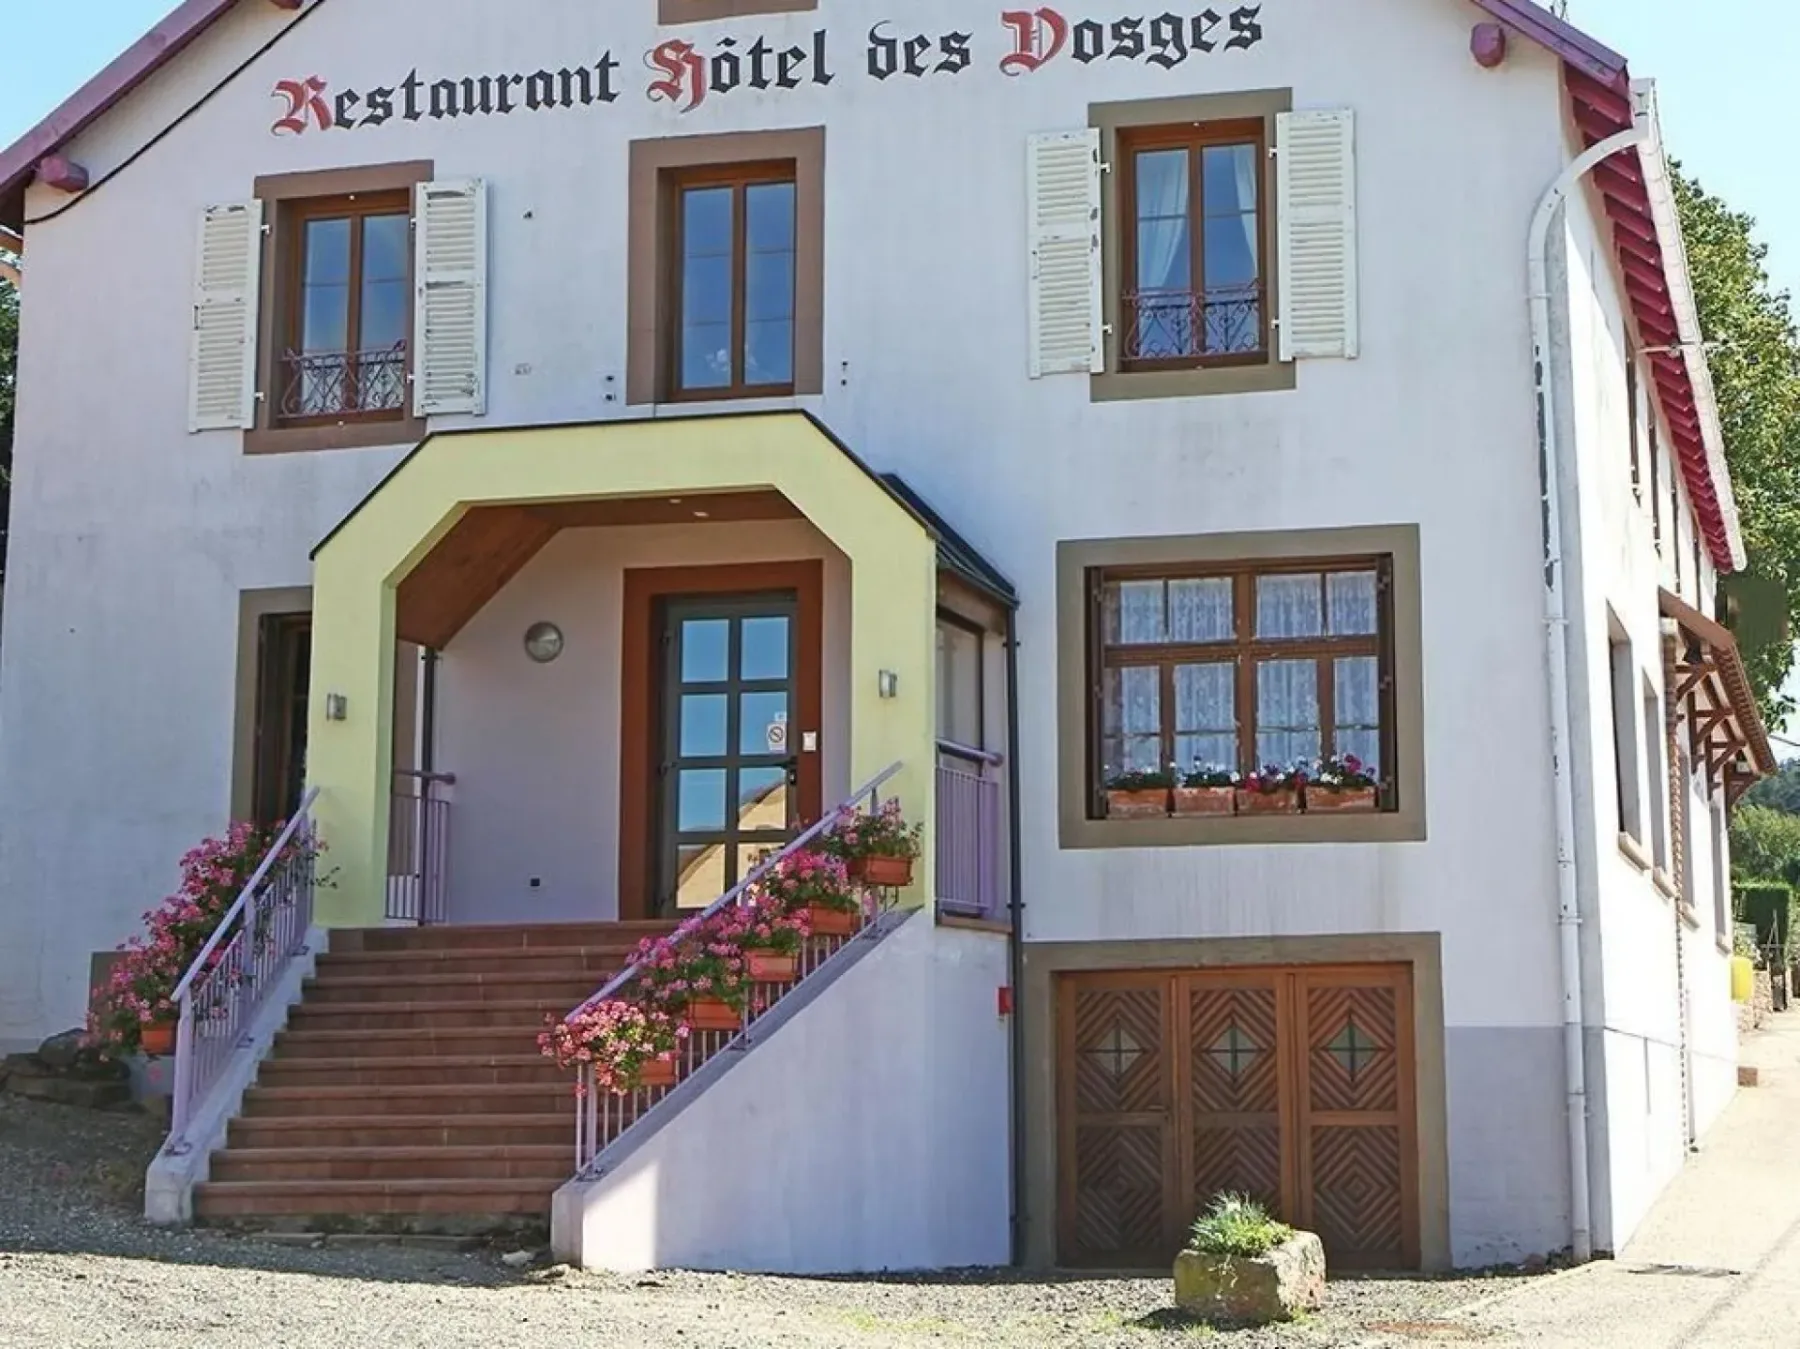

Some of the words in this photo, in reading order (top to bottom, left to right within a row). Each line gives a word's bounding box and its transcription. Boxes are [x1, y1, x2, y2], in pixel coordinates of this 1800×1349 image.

[271, 50, 621, 136] Restaurant
[644, 27, 836, 114] Hôtel
[867, 20, 973, 81] des
[1000, 3, 1264, 75] Vosges
